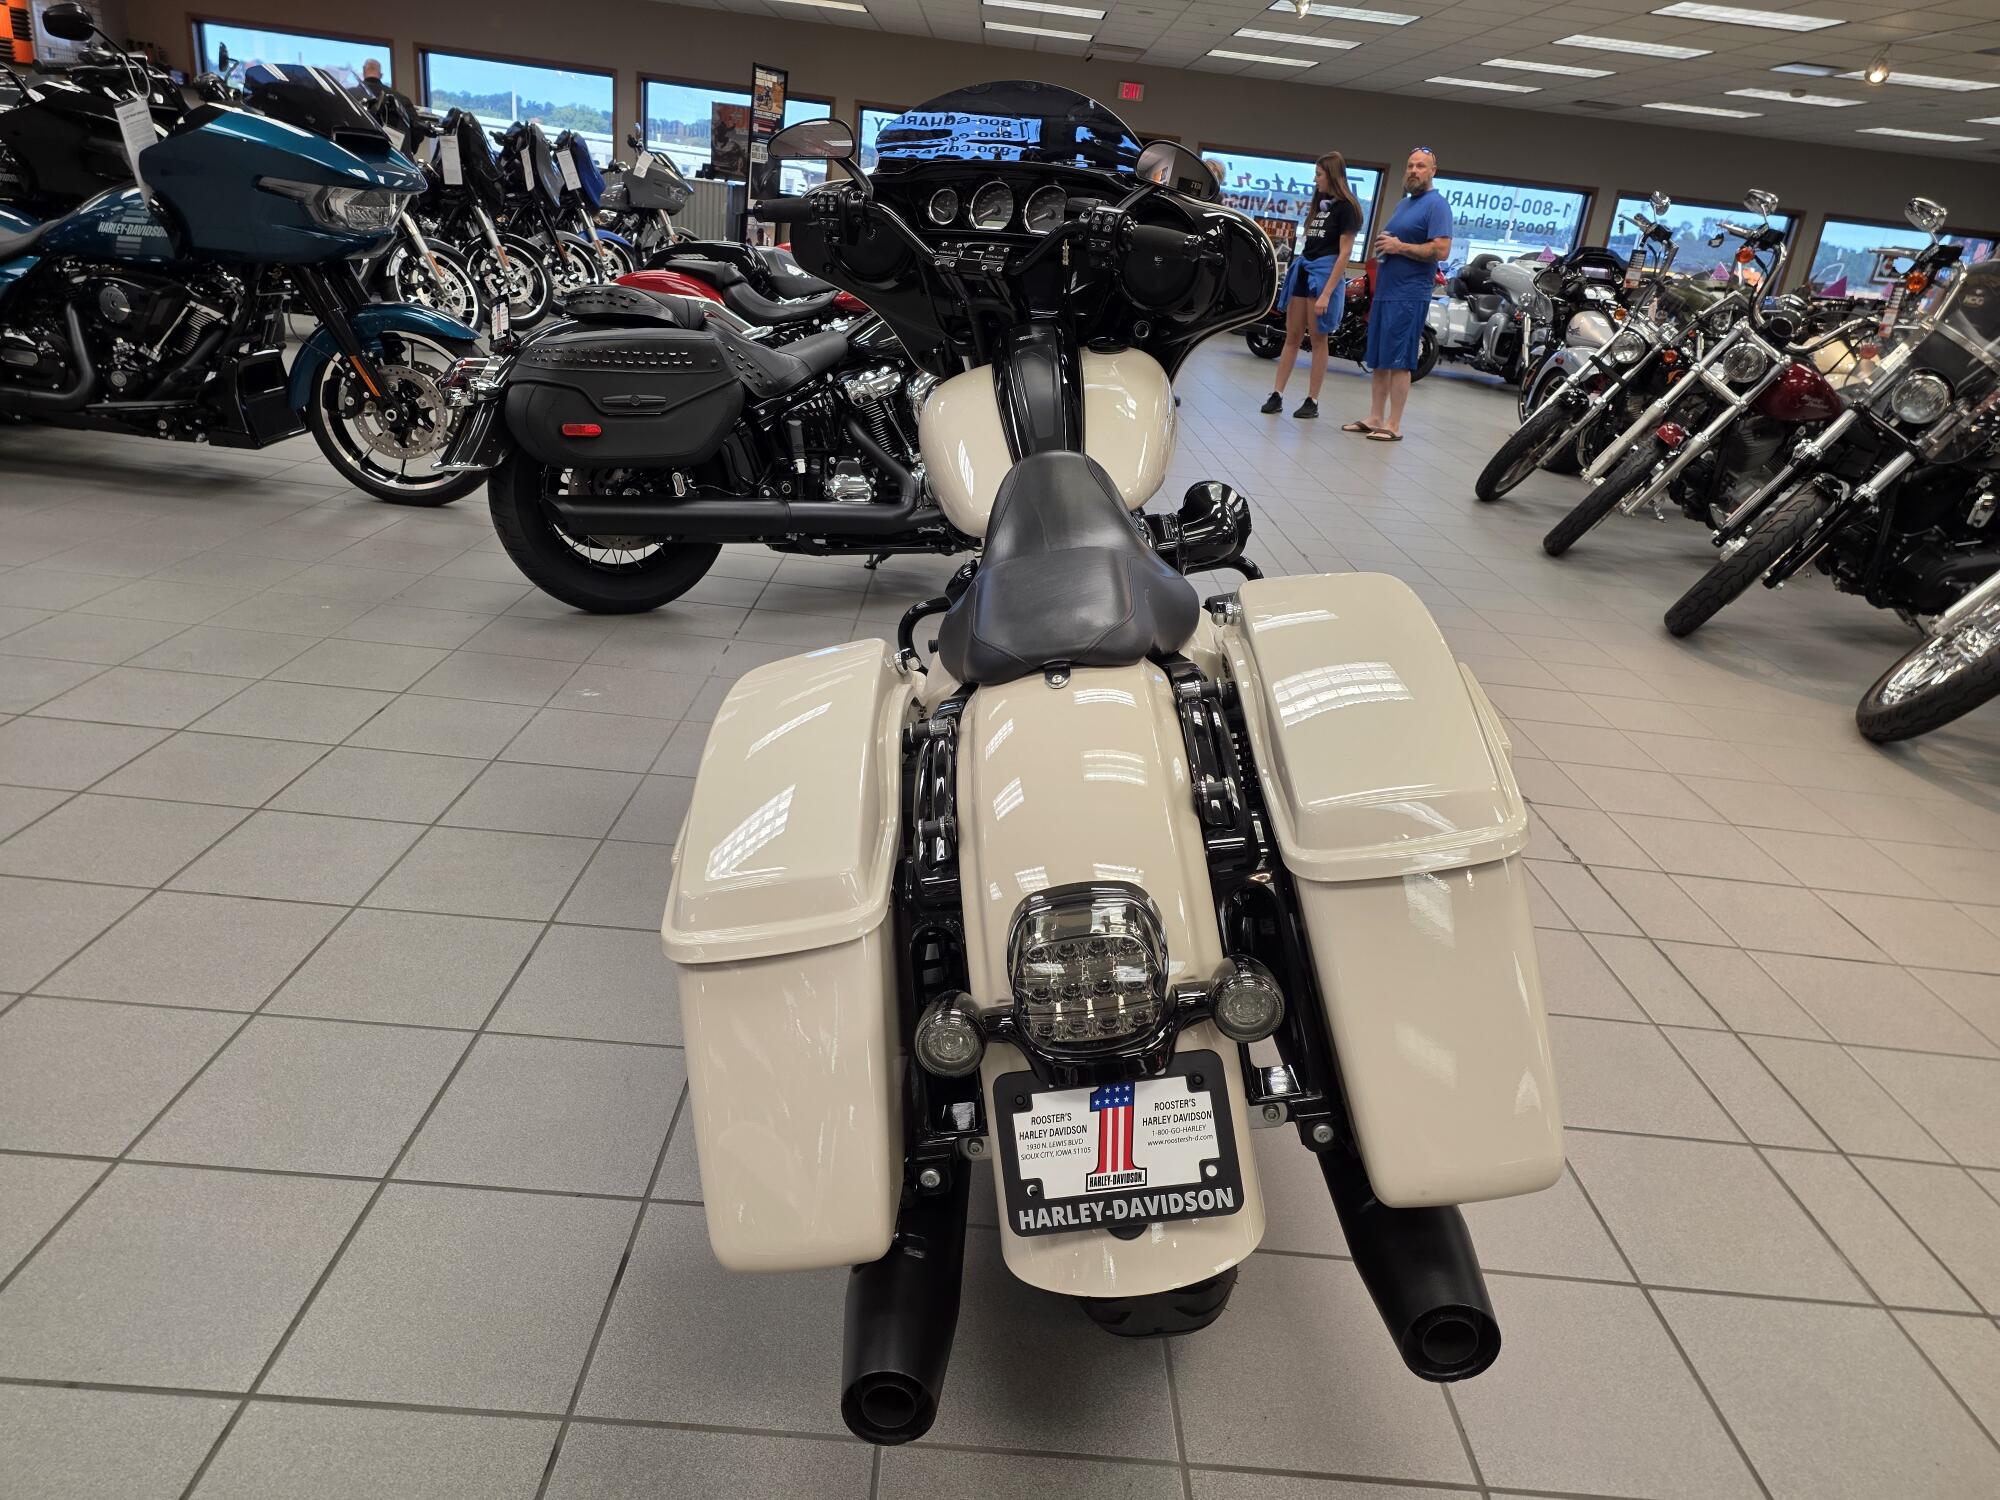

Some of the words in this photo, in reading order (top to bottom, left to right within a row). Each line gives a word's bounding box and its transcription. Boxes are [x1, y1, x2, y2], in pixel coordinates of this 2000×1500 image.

[1122, 83, 1141, 99] EXIT
[1154, 1098, 1196, 1112] ROOSTER'S
[1031, 1112, 1072, 1126] ROOSTER'S
[1142, 1114, 1172, 1126] HARLEY
[1173, 1110, 1212, 1123] DAVIDSON
[1019, 1128, 1048, 1140] HARLEY
[1049, 1124, 1088, 1137] DAVIDSON
[1152, 1124, 1207, 1136] 1-800-GO-HARLEY
[1026, 1143, 1041, 1151] 1930
[1049, 1140, 1067, 1148] LEWIS
[1067, 1138, 1084, 1146] BLVD
[1147, 1134, 1214, 1146] www.roostersh-d.com
[1020, 1152, 1040, 1161] SIOUX
[1040, 1150, 1055, 1159] CITY,
[1055, 1148, 1072, 1157] IOWA
[1072, 1146, 1092, 1155] 51105
[1018, 1187, 1236, 1231] HARLEY-DAVIDSON
